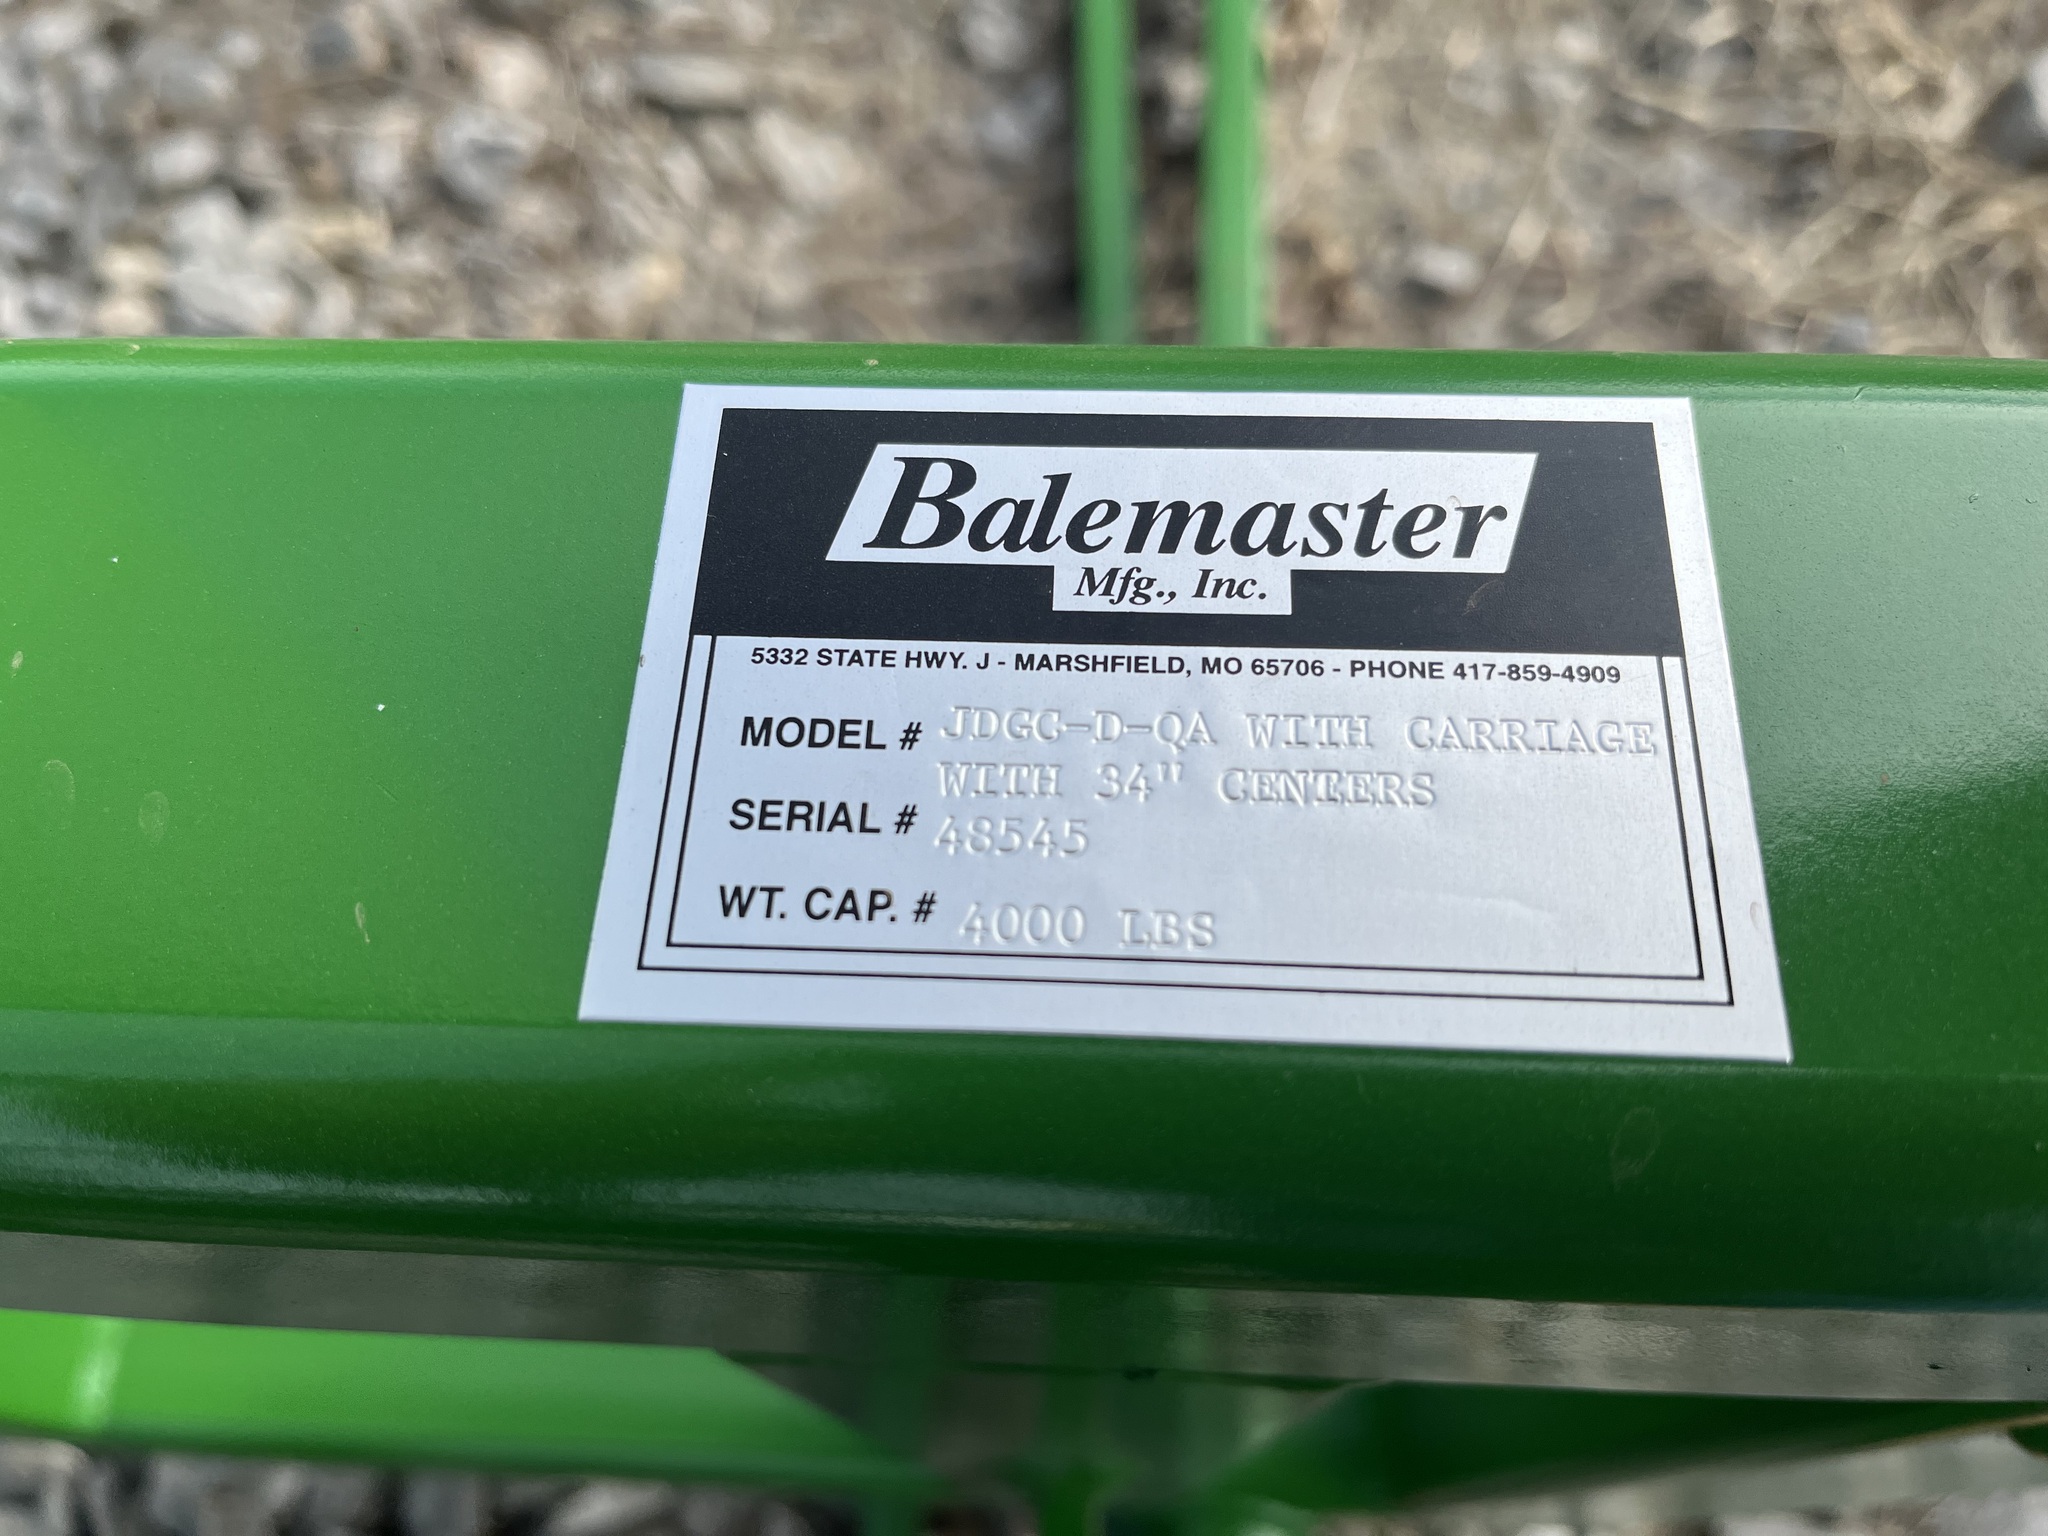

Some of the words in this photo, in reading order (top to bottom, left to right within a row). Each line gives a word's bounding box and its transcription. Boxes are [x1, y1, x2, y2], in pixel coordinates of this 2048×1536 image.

[862, 455, 1508, 558] Balemaster
[1073, 566, 1177, 607] Mfg.,
[1191, 569, 1268, 600] Inc.
[750, 646, 809, 666] 5332
[816, 648, 897, 668] STATE
[904, 650, 968, 670] HWY.
[976, 653, 990, 671] J
[1014, 654, 1192, 677] MARSHFIELD,
[1201, 657, 1243, 676] MO
[1250, 659, 1326, 678] 65706
[1350, 660, 1446, 680] PHONE
[1452, 662, 1622, 684] 417-859-4909
[740, 716, 886, 750] MODEL
[899, 721, 922, 750] #
[1245, 712, 1373, 750] WITH
[1403, 716, 1657, 758] CARRIAGE
[936, 762, 1063, 799] WITH
[1095, 761, 1184, 802] 34"
[1216, 768, 1437, 808] CENTERS
[729, 798, 880, 834] SERIAL
[894, 804, 917, 834] #
[933, 815, 1089, 859] 48545
[719, 885, 787, 918] WT.
[804, 887, 897, 922] CAP.
[913, 891, 936, 922] #
[957, 901, 1087, 947] 4000
[1117, 908, 1217, 950] LBS
